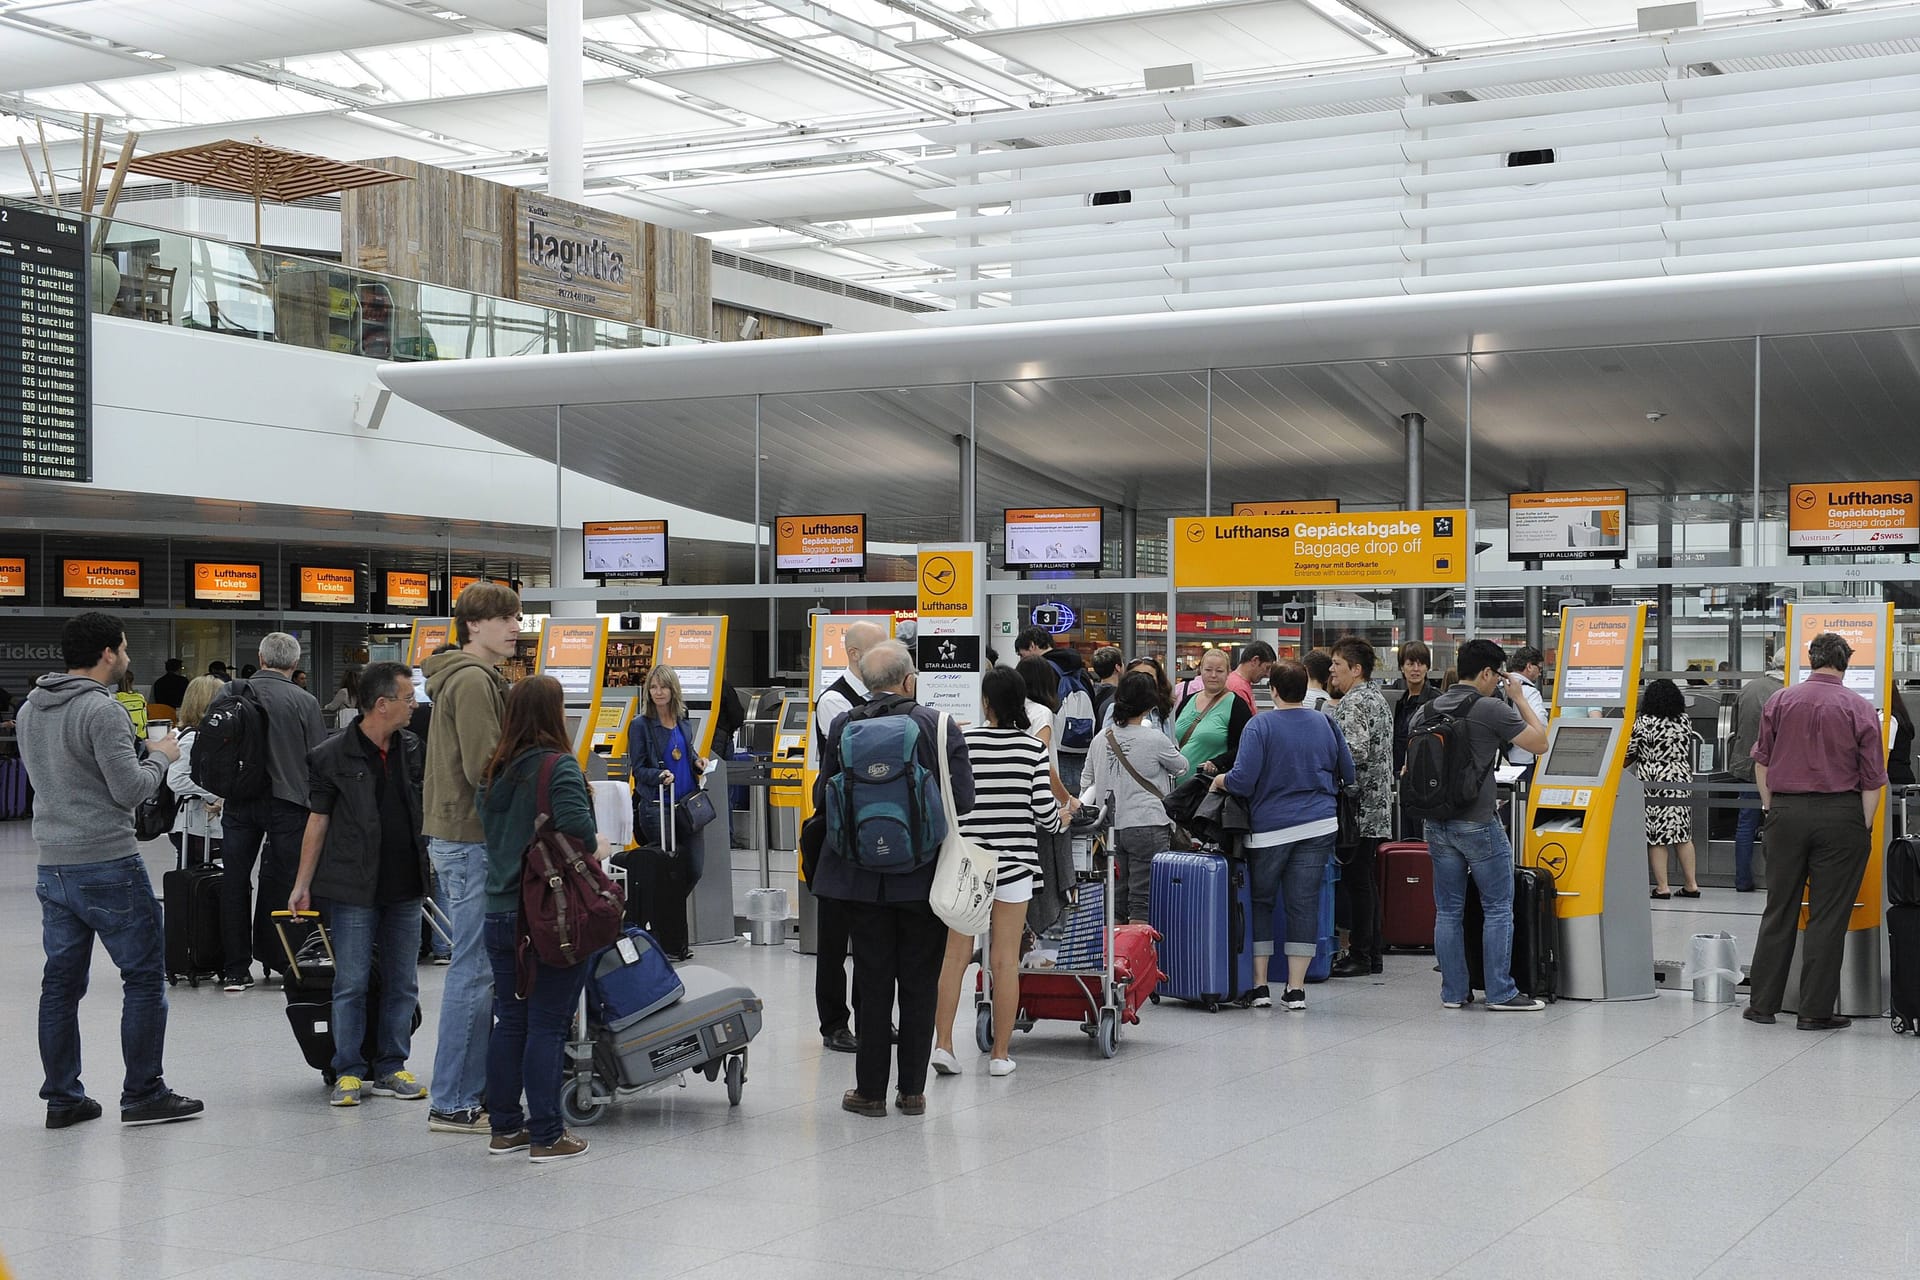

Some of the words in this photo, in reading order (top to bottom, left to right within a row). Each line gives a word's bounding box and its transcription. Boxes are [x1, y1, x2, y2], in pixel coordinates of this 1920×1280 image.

[2, 210, 8, 222] 2
[57, 222, 76, 234] 10:44
[528, 220, 624, 284] bagutta
[37, 265, 73, 279] Lufthansa
[37, 279, 74, 292] cancelled
[38, 290, 74, 304] Lufthansa
[38, 303, 74, 316] Lufthansa
[38, 317, 74, 329] cancelled
[38, 328, 74, 341] Lufthansa
[38, 341, 74, 354] Lufthansa
[38, 355, 74, 366] cancelled
[38, 366, 74, 378] Lufthansa
[38, 379, 74, 391] Lufthansa
[38, 391, 74, 403] Lufthansa
[38, 404, 74, 416] Lufthansa
[39, 416, 74, 428] Lufthansa
[39, 429, 74, 441] Lufthansa
[39, 442, 74, 453] Lufthansa
[39, 456, 74, 465] cancelled
[39, 467, 75, 478] Lufthansa
[1828, 491, 1913, 505] Lufthansa
[1828, 508, 1905, 518] Gepäckabgabe
[802, 524, 858, 535] Lufthansa
[1828, 519, 1868, 529] Baggage
[1870, 518, 1891, 528] drop
[1894, 518, 1905, 526] off
[1215, 524, 1289, 540] Lufthansa
[1294, 521, 1421, 539] Gepäckabgabe
[802, 537, 854, 545] Gepäckabgabe
[802, 546, 830, 555] Baggage
[831, 545, 844, 553] drop
[1294, 541, 1360, 558] Baggage
[1365, 540, 1398, 556] drop
[1403, 538, 1422, 553] off
[87, 566, 136, 576] Lufthansa
[214, 569, 256, 579] Lufthansa
[86, 576, 124, 586] Tickets
[317, 573, 352, 582] Lufthansa
[399, 577, 426, 586] Lufthansa
[215, 579, 247, 589] Tickets
[317, 583, 344, 592] Tickets
[400, 587, 420, 595] Tickets
[922, 601, 968, 611] Lufthansa
[1044, 614, 1049, 622] 3
[1291, 612, 1298, 621] 4
[628, 619, 633, 628] 1
[1589, 621, 1626, 629] Lufthansa
[1824, 619, 1873, 627] Lufthansa
[416, 646, 422, 658] 1
[548, 645, 556, 659] 1
[666, 645, 673, 659] 1
[825, 646, 833, 658] 1
[1573, 642, 1580, 657] 1
